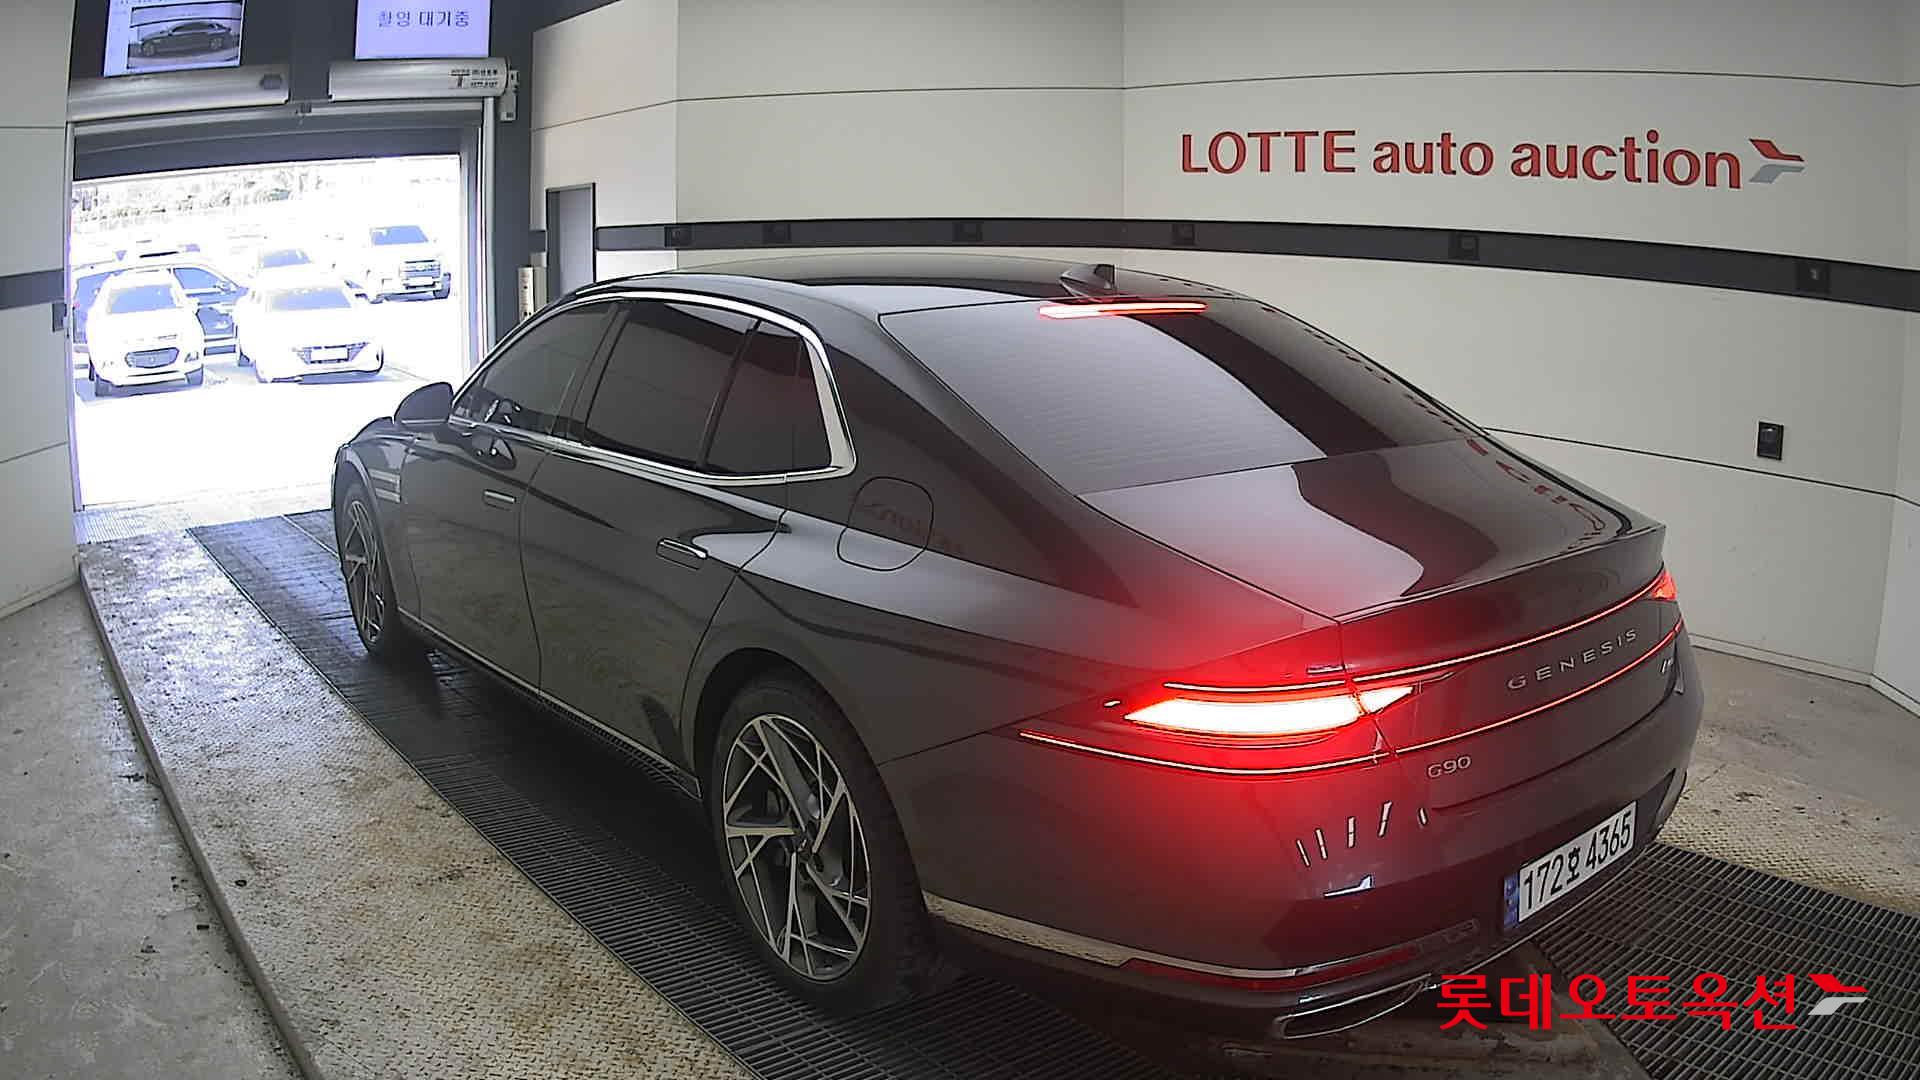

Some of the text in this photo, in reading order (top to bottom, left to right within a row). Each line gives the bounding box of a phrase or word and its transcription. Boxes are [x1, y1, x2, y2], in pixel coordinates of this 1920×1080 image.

[419, 10, 470, 28] 대기중
[1181, 129, 1742, 189] LOTTE auto auction
[1506, 627, 1638, 690] GENESIS
[1426, 755, 1473, 779] G90
[1585, 810, 1632, 870] 4365
